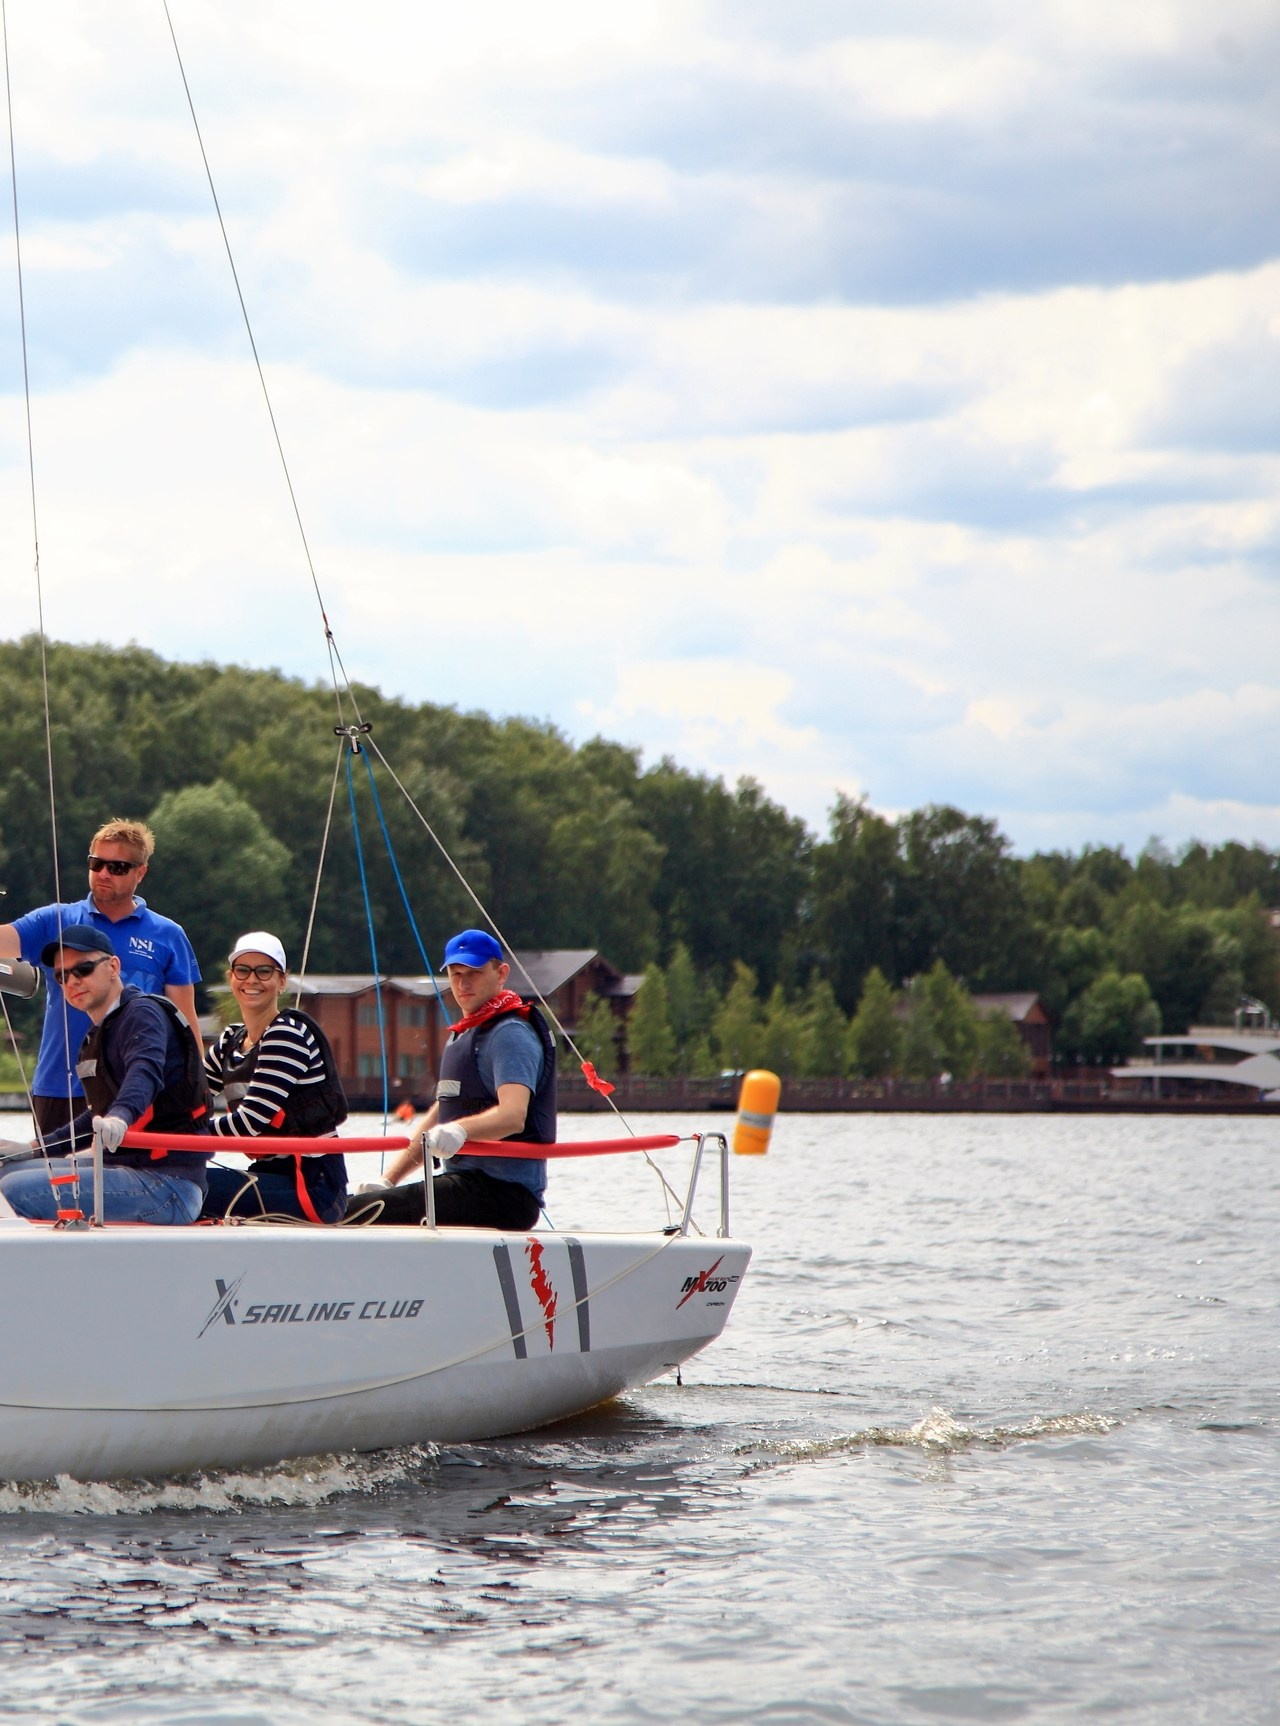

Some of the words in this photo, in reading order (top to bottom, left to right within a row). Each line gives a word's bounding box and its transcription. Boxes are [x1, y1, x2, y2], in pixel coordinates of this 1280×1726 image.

[129, 936, 155, 953] NSL
[241, 1302, 355, 1325] SAILING
[357, 1299, 425, 1320] CLUB
